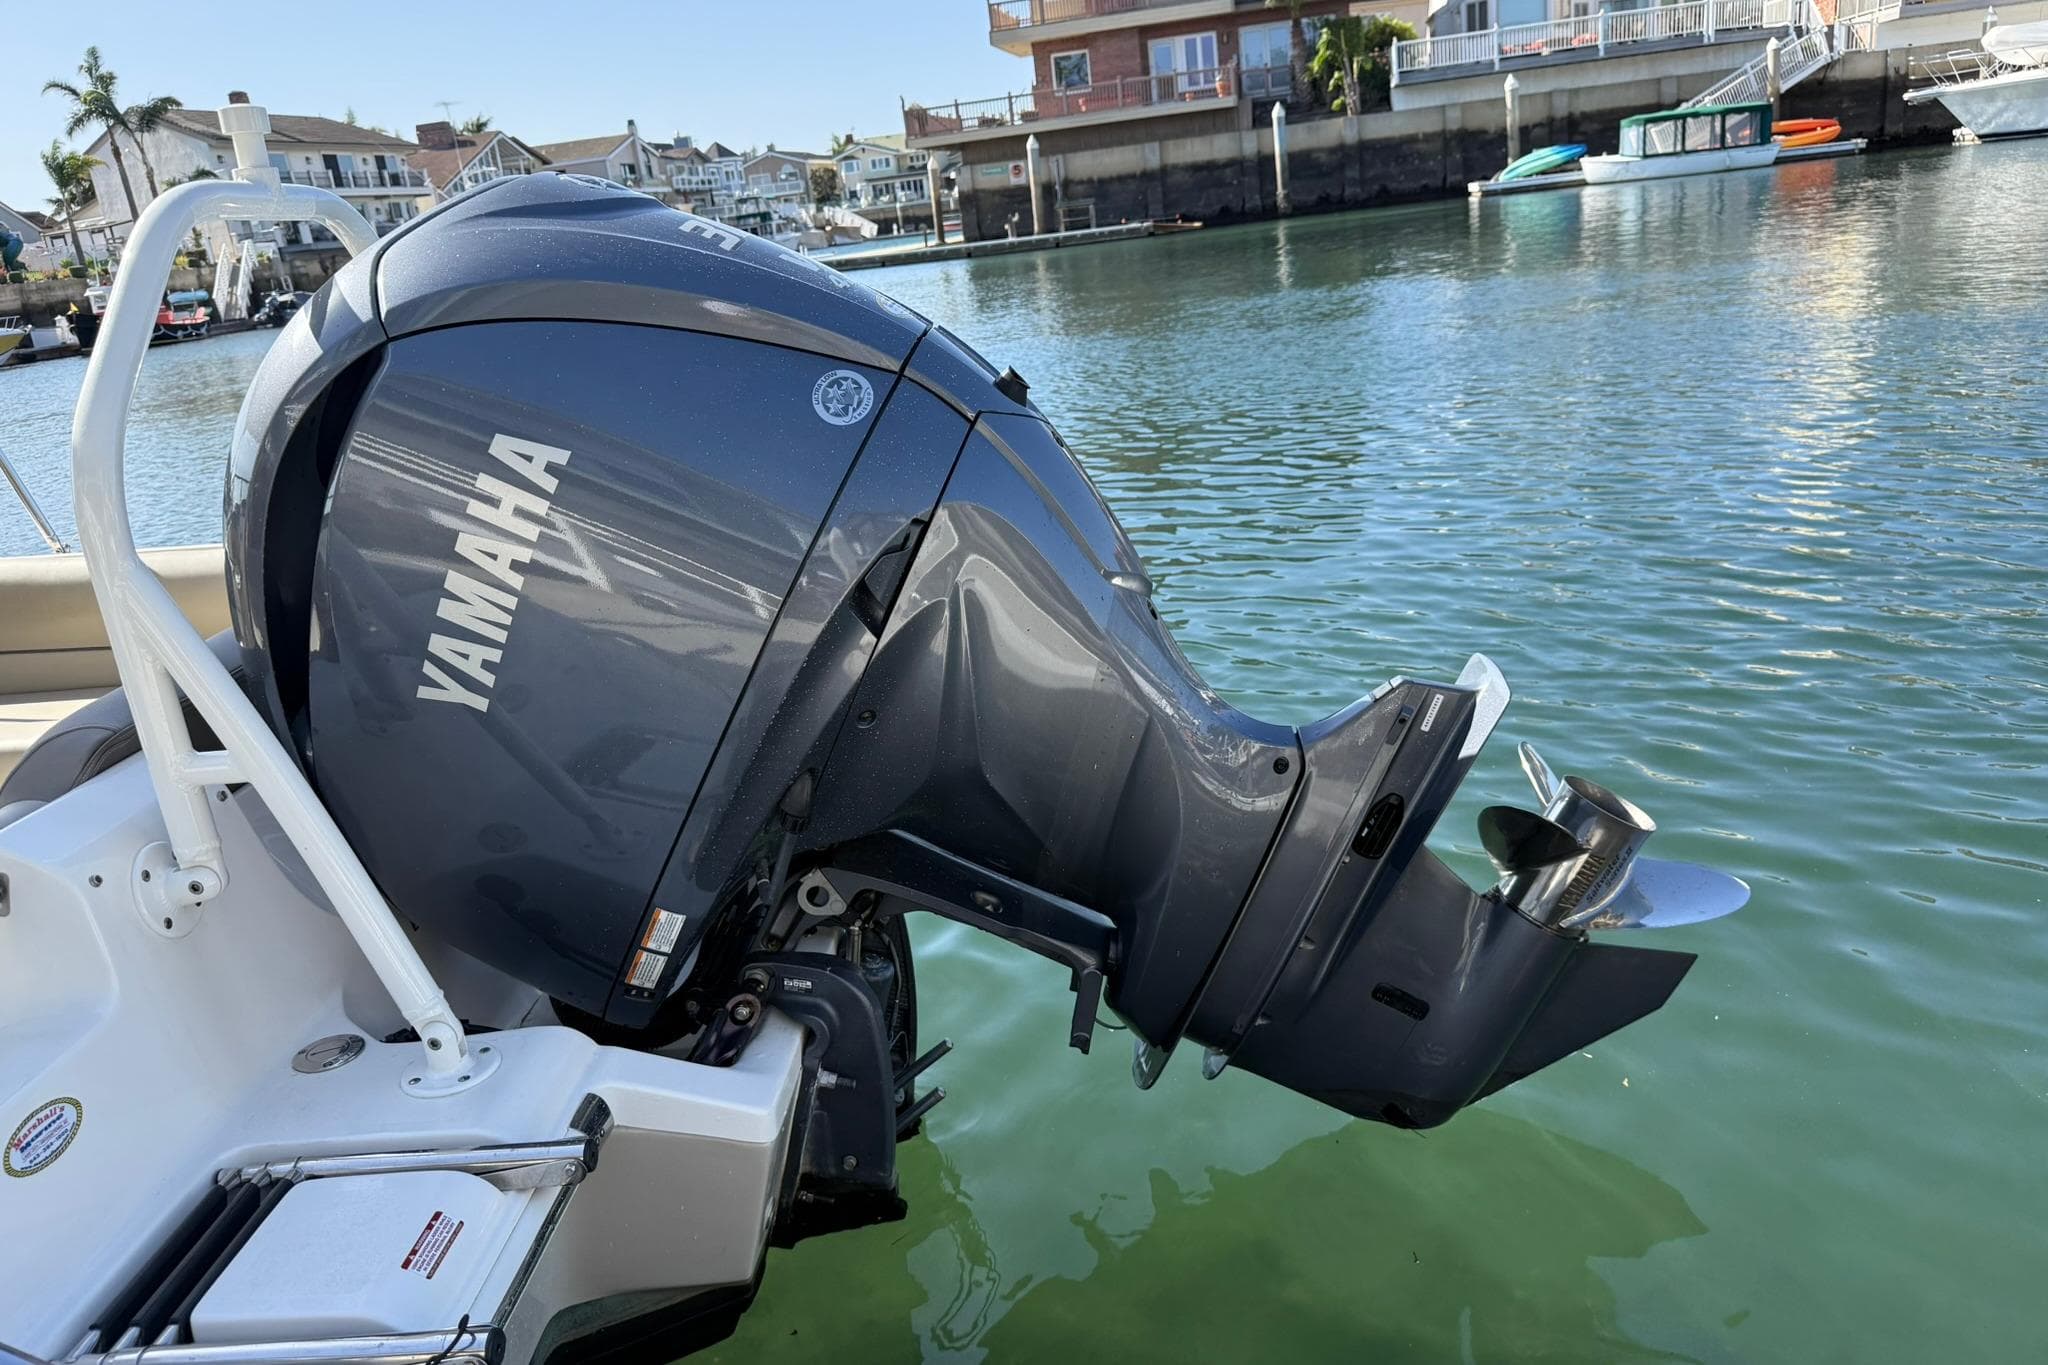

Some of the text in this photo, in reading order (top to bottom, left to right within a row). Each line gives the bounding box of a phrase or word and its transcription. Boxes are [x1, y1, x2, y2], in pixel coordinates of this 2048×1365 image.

[813, 370, 838, 406] ULTRA LOW
[416, 433, 572, 712] YAMAHA
[1558, 854, 1606, 909] YAMAHA
